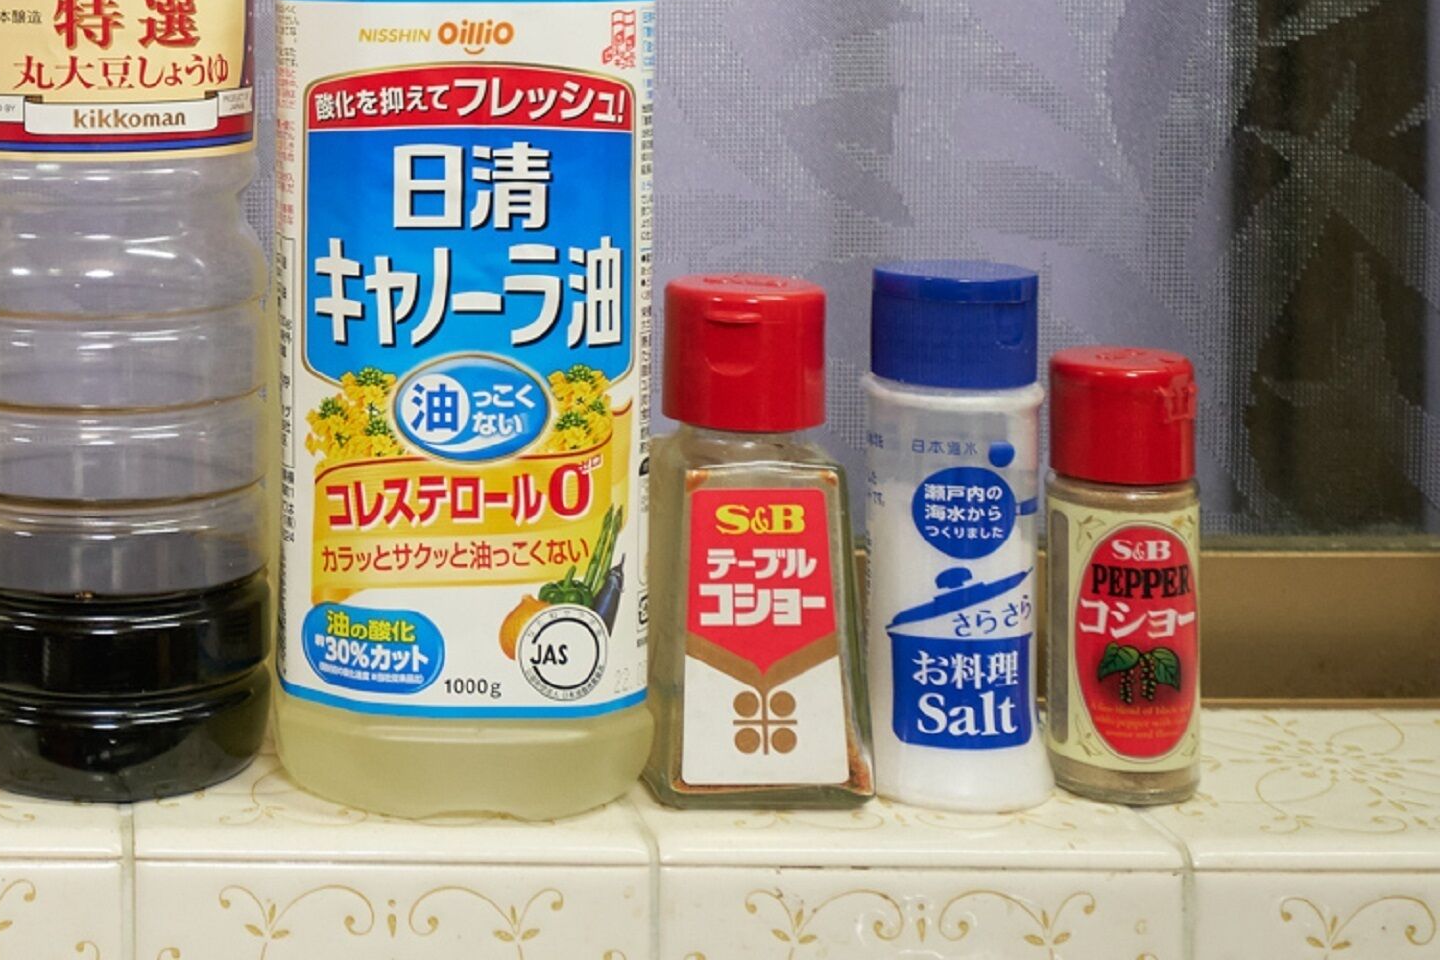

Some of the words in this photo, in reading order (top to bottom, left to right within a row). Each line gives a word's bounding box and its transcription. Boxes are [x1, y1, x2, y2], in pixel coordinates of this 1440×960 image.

[358, 28, 431, 43] NISSHIN
[13, 53, 229, 90] 丸大豆しょうゆ
[73, 108, 186, 129] kikkoman
[393, 141, 552, 230] 日清
[314, 236, 622, 347] キャノーラ油
[410, 383, 458, 433] 油
[473, 412, 524, 437] ない
[924, 483, 1003, 503] 瀬戸内の
[715, 504, 805, 535] S&B
[924, 503, 1002, 523] 海水から
[924, 525, 1004, 539] つくりました
[321, 538, 590, 573] カラッとサクッと油っこくない
[707, 548, 817, 580] テーブル
[1111, 539, 1172, 562] S&B
[1091, 562, 1191, 599] PEPPER
[698, 583, 827, 627] コショー
[952, 594, 1032, 637] さらさら
[1079, 598, 1196, 639] コショー
[326, 610, 416, 642] 油の酸化
[529, 643, 568, 665] JAS
[912, 650, 1019, 690] お料理
[916, 690, 1019, 736] Salt
